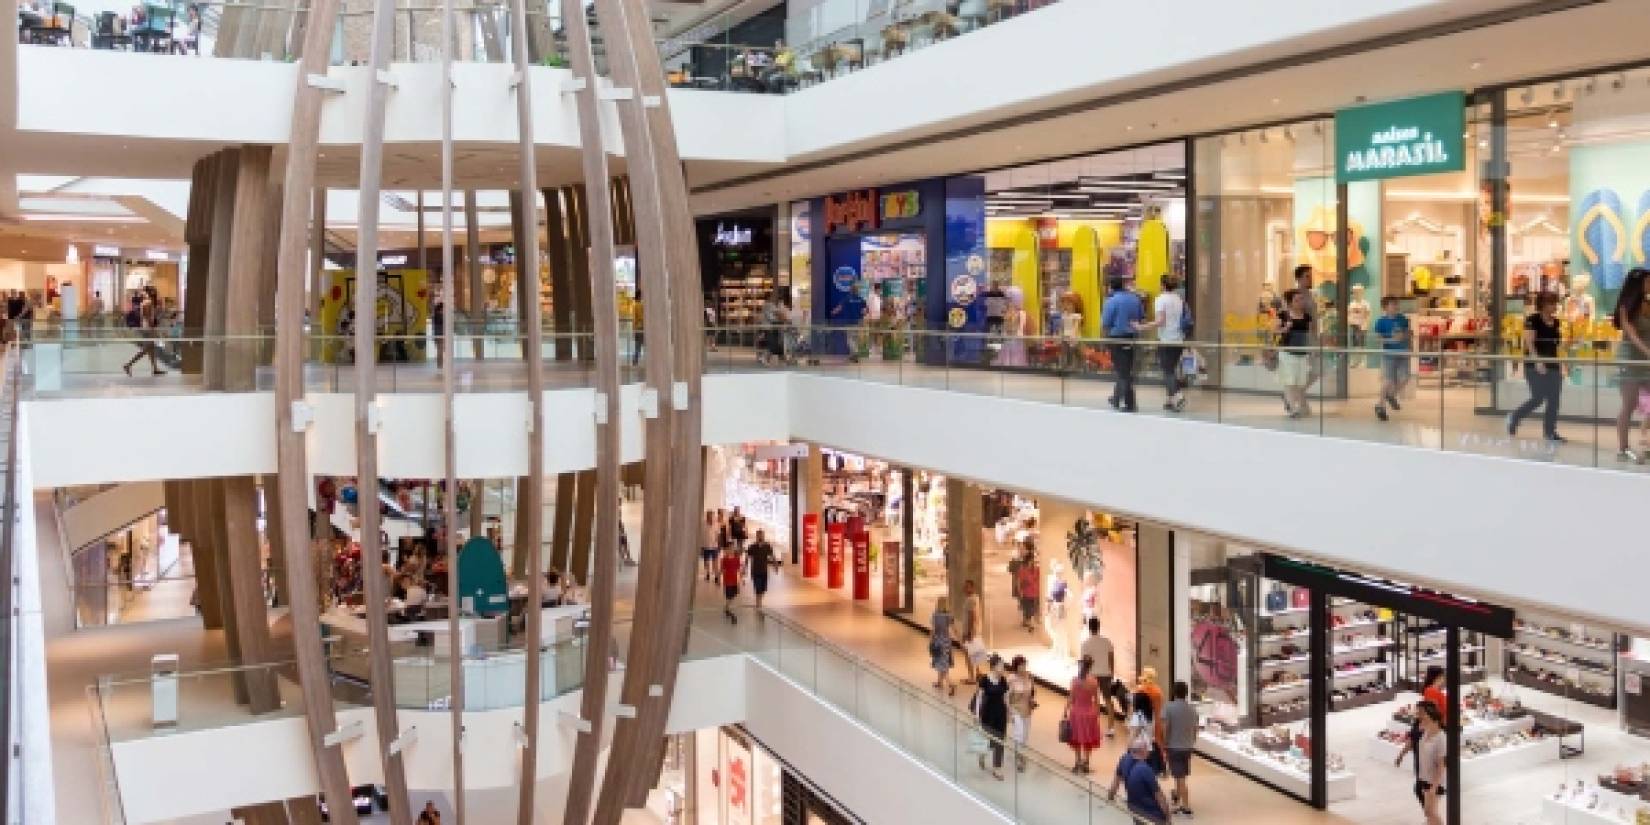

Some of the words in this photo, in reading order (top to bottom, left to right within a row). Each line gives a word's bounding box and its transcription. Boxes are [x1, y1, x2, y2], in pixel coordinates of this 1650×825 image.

[806, 524, 817, 554] SALE
[831, 533, 843, 562] SALE
[857, 541, 867, 573] SALE
